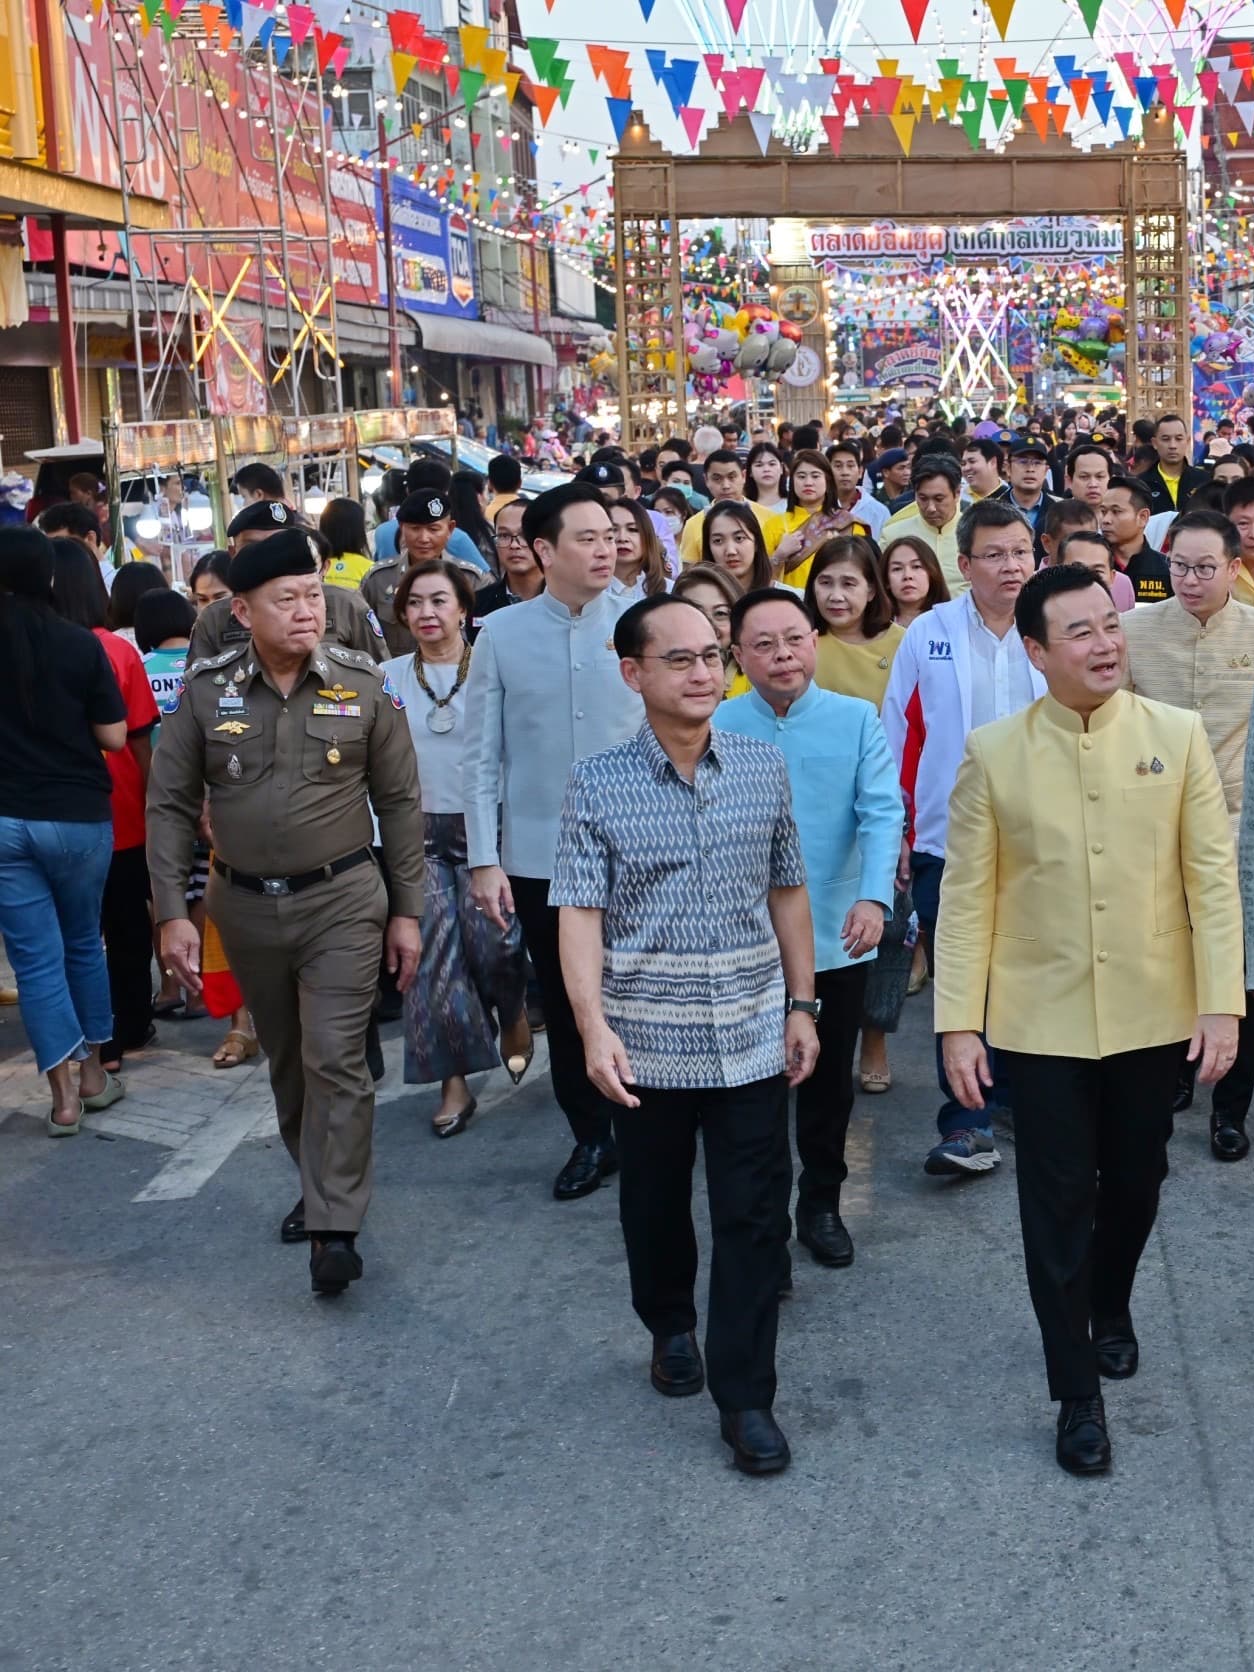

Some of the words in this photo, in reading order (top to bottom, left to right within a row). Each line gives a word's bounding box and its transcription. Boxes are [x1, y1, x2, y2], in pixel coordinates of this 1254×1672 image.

[953, 224, 1140, 250] เทศกาลเที่ยวพิม
